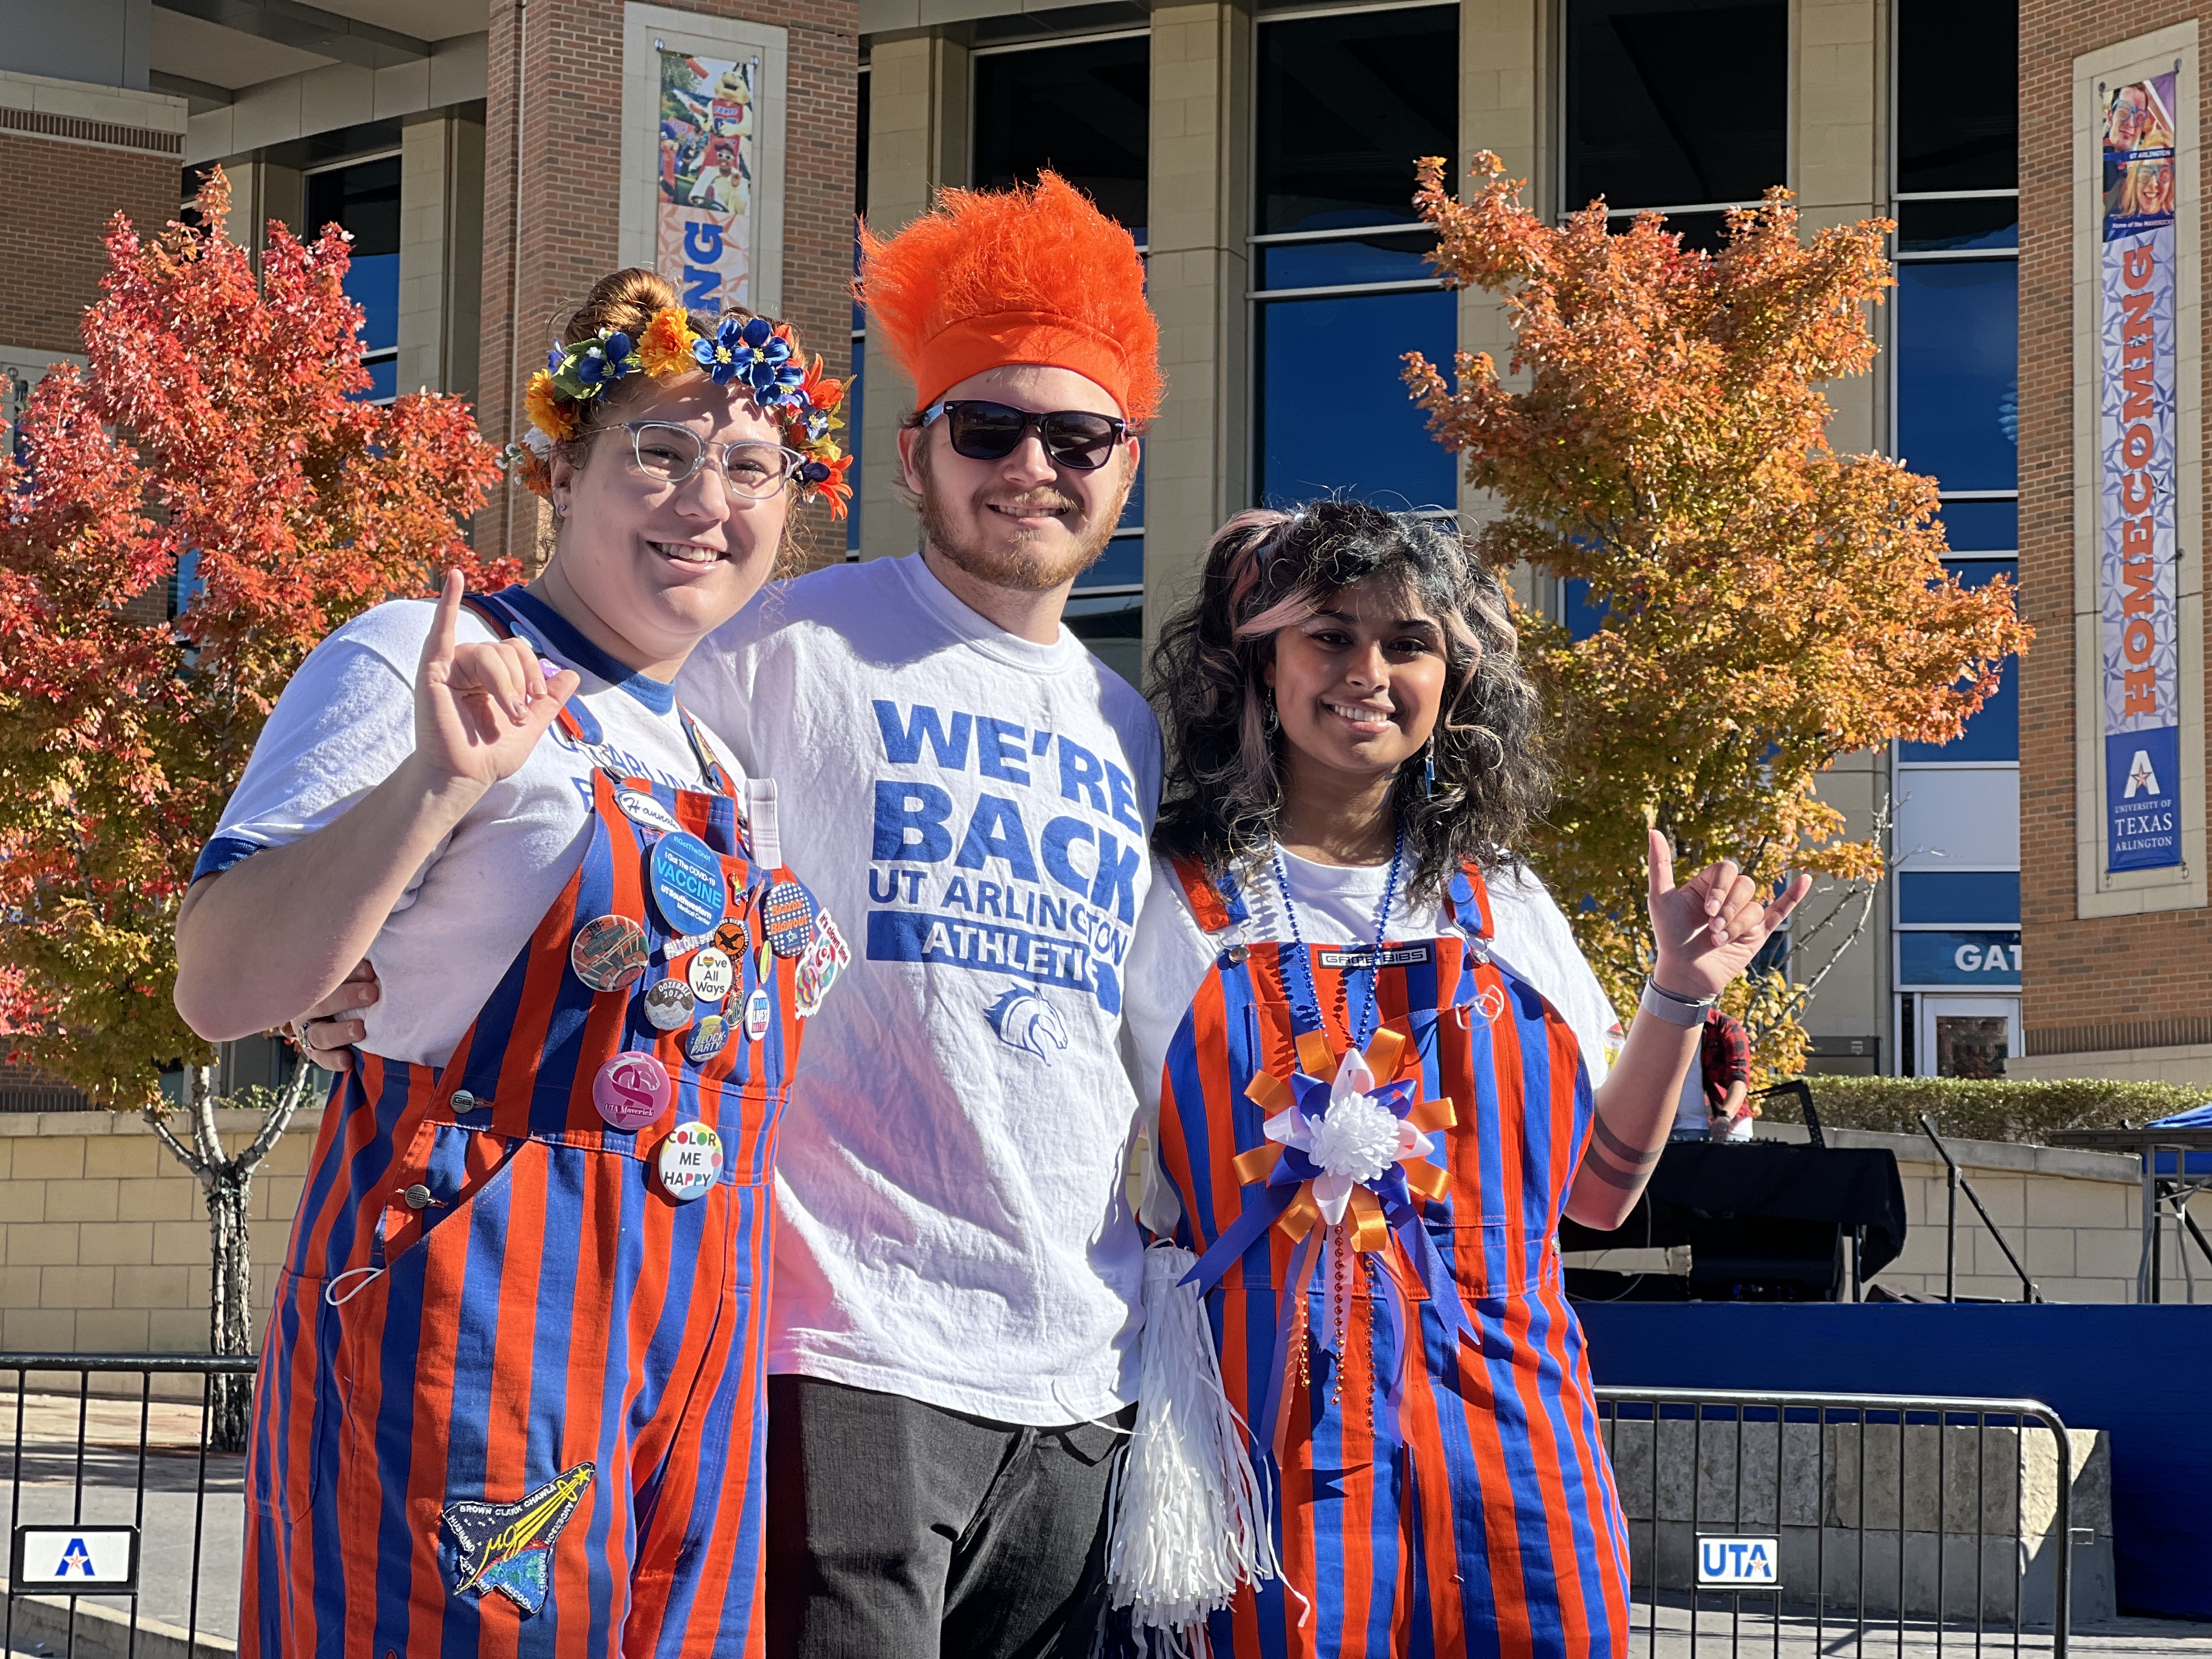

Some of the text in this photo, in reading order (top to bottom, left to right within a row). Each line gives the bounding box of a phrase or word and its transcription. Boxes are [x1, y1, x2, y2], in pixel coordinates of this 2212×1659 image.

[2123, 243, 2156, 718] HOMECOMING
[872, 699, 1143, 838] WE'RE
[2115, 799, 2172, 814] UNIVERSITY OF
[2115, 812, 2172, 836] TEXAS
[2115, 836, 2172, 852] ARLINGTON
[872, 780, 1141, 928] BACK
[668, 853, 679, 865] Got
[679, 857, 689, 871] The
[689, 864, 716, 887] COVID-19
[657, 856, 723, 909] VACCINE
[661, 884, 712, 920] UT Southwestern
[771, 900, 803, 917] Brazos
[677, 902, 711, 926] Medical Center
[868, 868, 1128, 966] UT ARLINGTON
[770, 913, 808, 935] Blowout
[820, 913, 848, 963] It's clown time
[1325, 950, 1424, 964] GAME BIBS
[703, 970, 719, 981] All
[658, 982, 691, 997] OOZEBALL
[663, 990, 684, 1000] 2018
[696, 981, 725, 996] Ways
[753, 997, 768, 1010] TRANS
[753, 1009, 768, 1024] LIVES
[694, 1031, 725, 1045] BLOCK
[690, 1041, 722, 1054] PARTY
[604, 1103, 653, 1116] UTA Maverick
[667, 1130, 716, 1147] COLOR
[679, 1152, 702, 1166] ME
[663, 1171, 712, 1187] HAPPY
[460, 1483, 557, 1516] BROWN CLARK CHAWLA
[544, 1501, 574, 1545] ANDERSON
[54, 1538, 95, 1576] A
[1703, 1543, 1773, 1577] UTA
[461, 1559, 476, 1575] STS
[538, 1553, 547, 1584] RAMON
